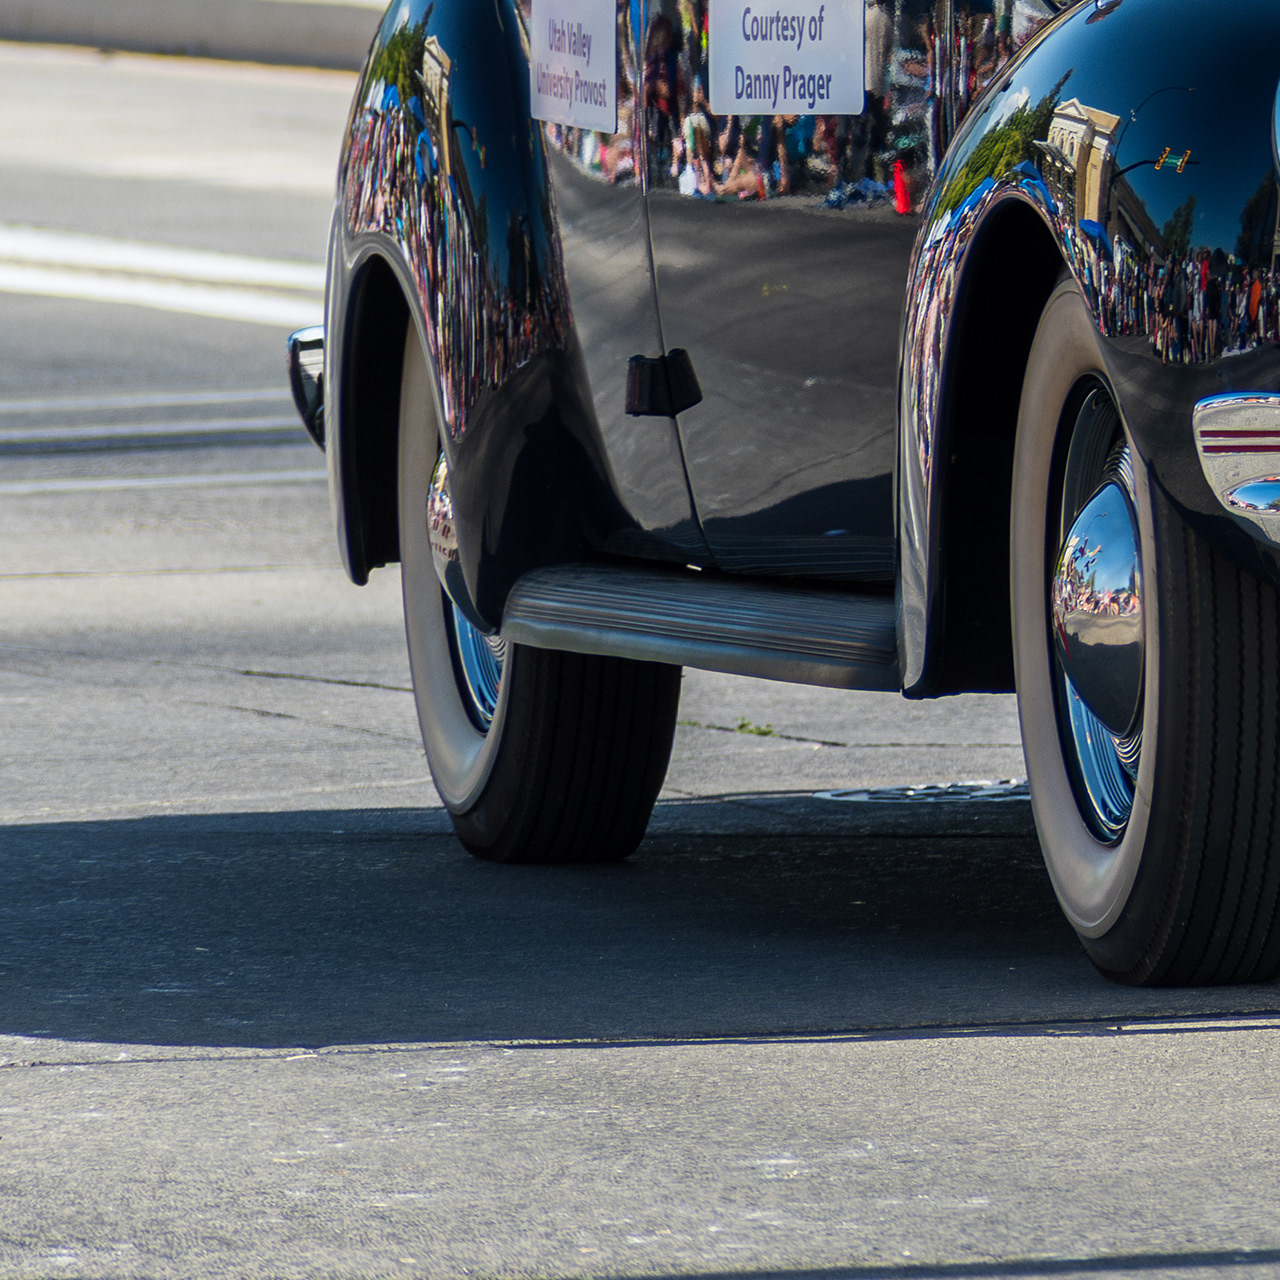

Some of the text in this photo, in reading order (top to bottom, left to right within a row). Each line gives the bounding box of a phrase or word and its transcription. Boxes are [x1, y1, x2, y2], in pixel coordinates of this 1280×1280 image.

[548, 18, 592, 68] Utah Valley
[742, 4, 825, 52] Courtesy of
[537, 62, 607, 110] University Provost
[735, 65, 832, 110] Danny Prager
